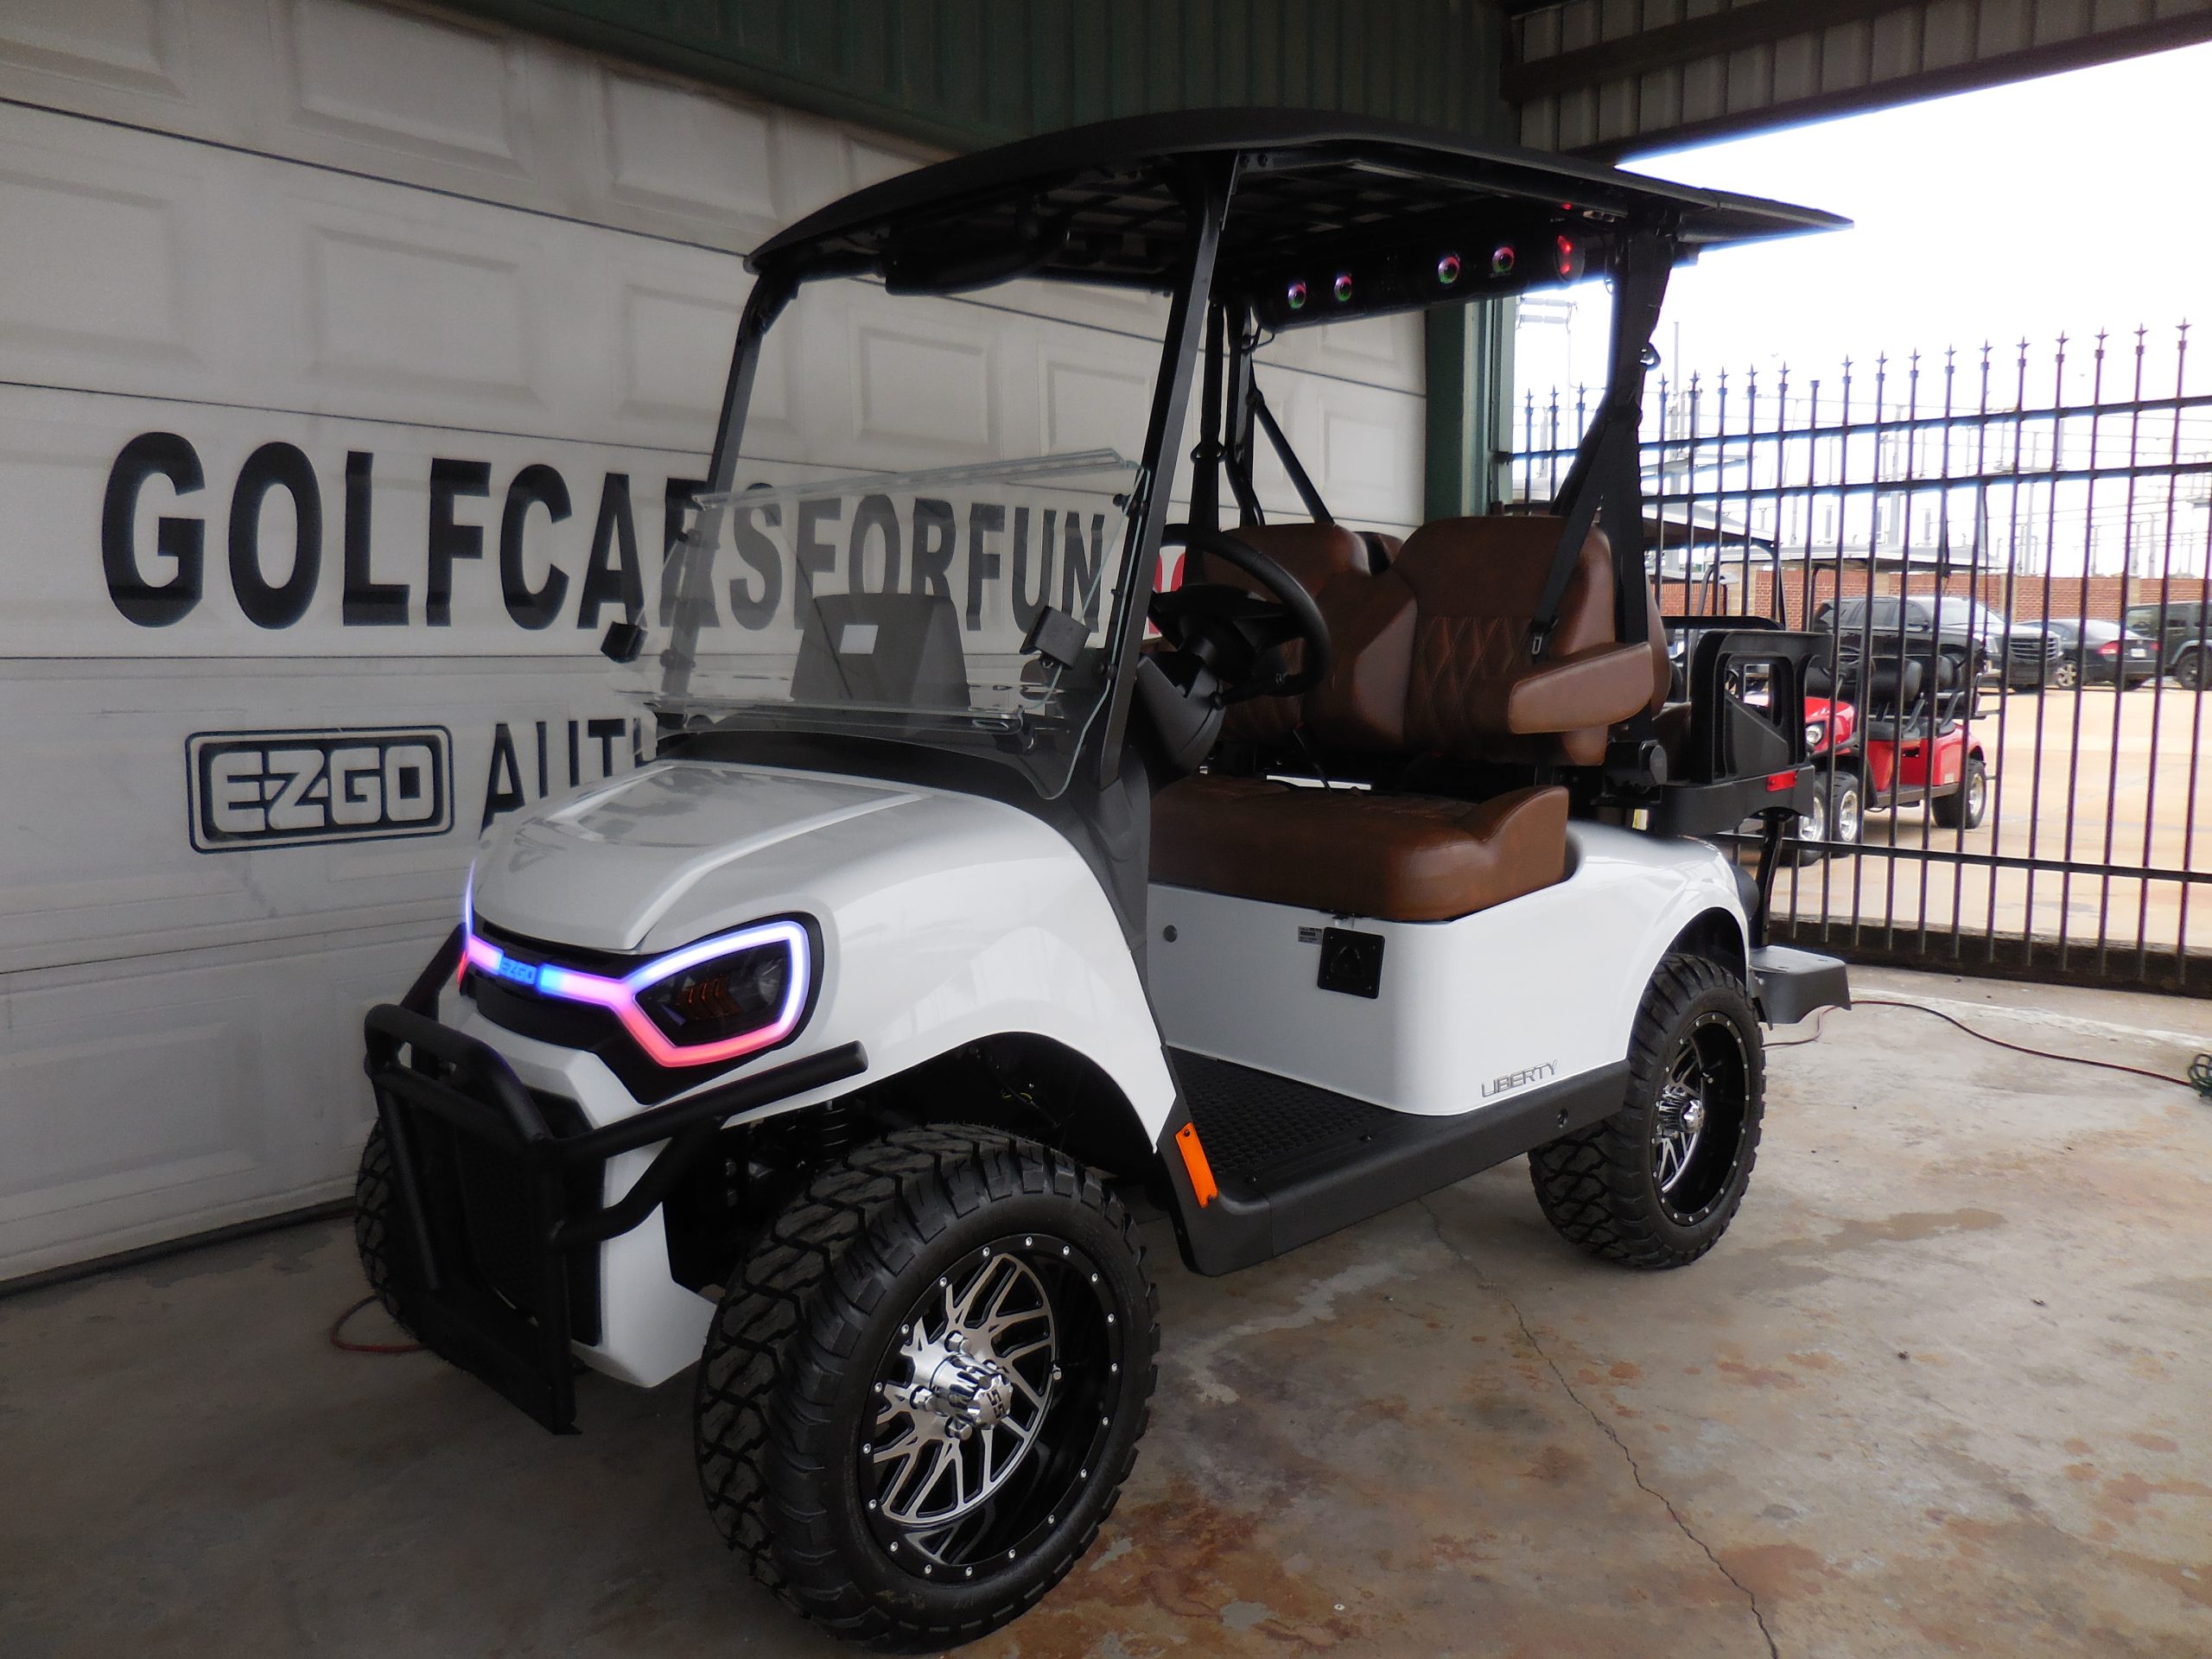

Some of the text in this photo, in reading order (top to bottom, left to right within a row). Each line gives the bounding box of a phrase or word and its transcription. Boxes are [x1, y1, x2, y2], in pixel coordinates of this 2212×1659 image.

[208, 743, 437, 833] EZGO
[478, 718, 643, 841] AUT
[1481, 1058, 1557, 1097] LIBERTY
